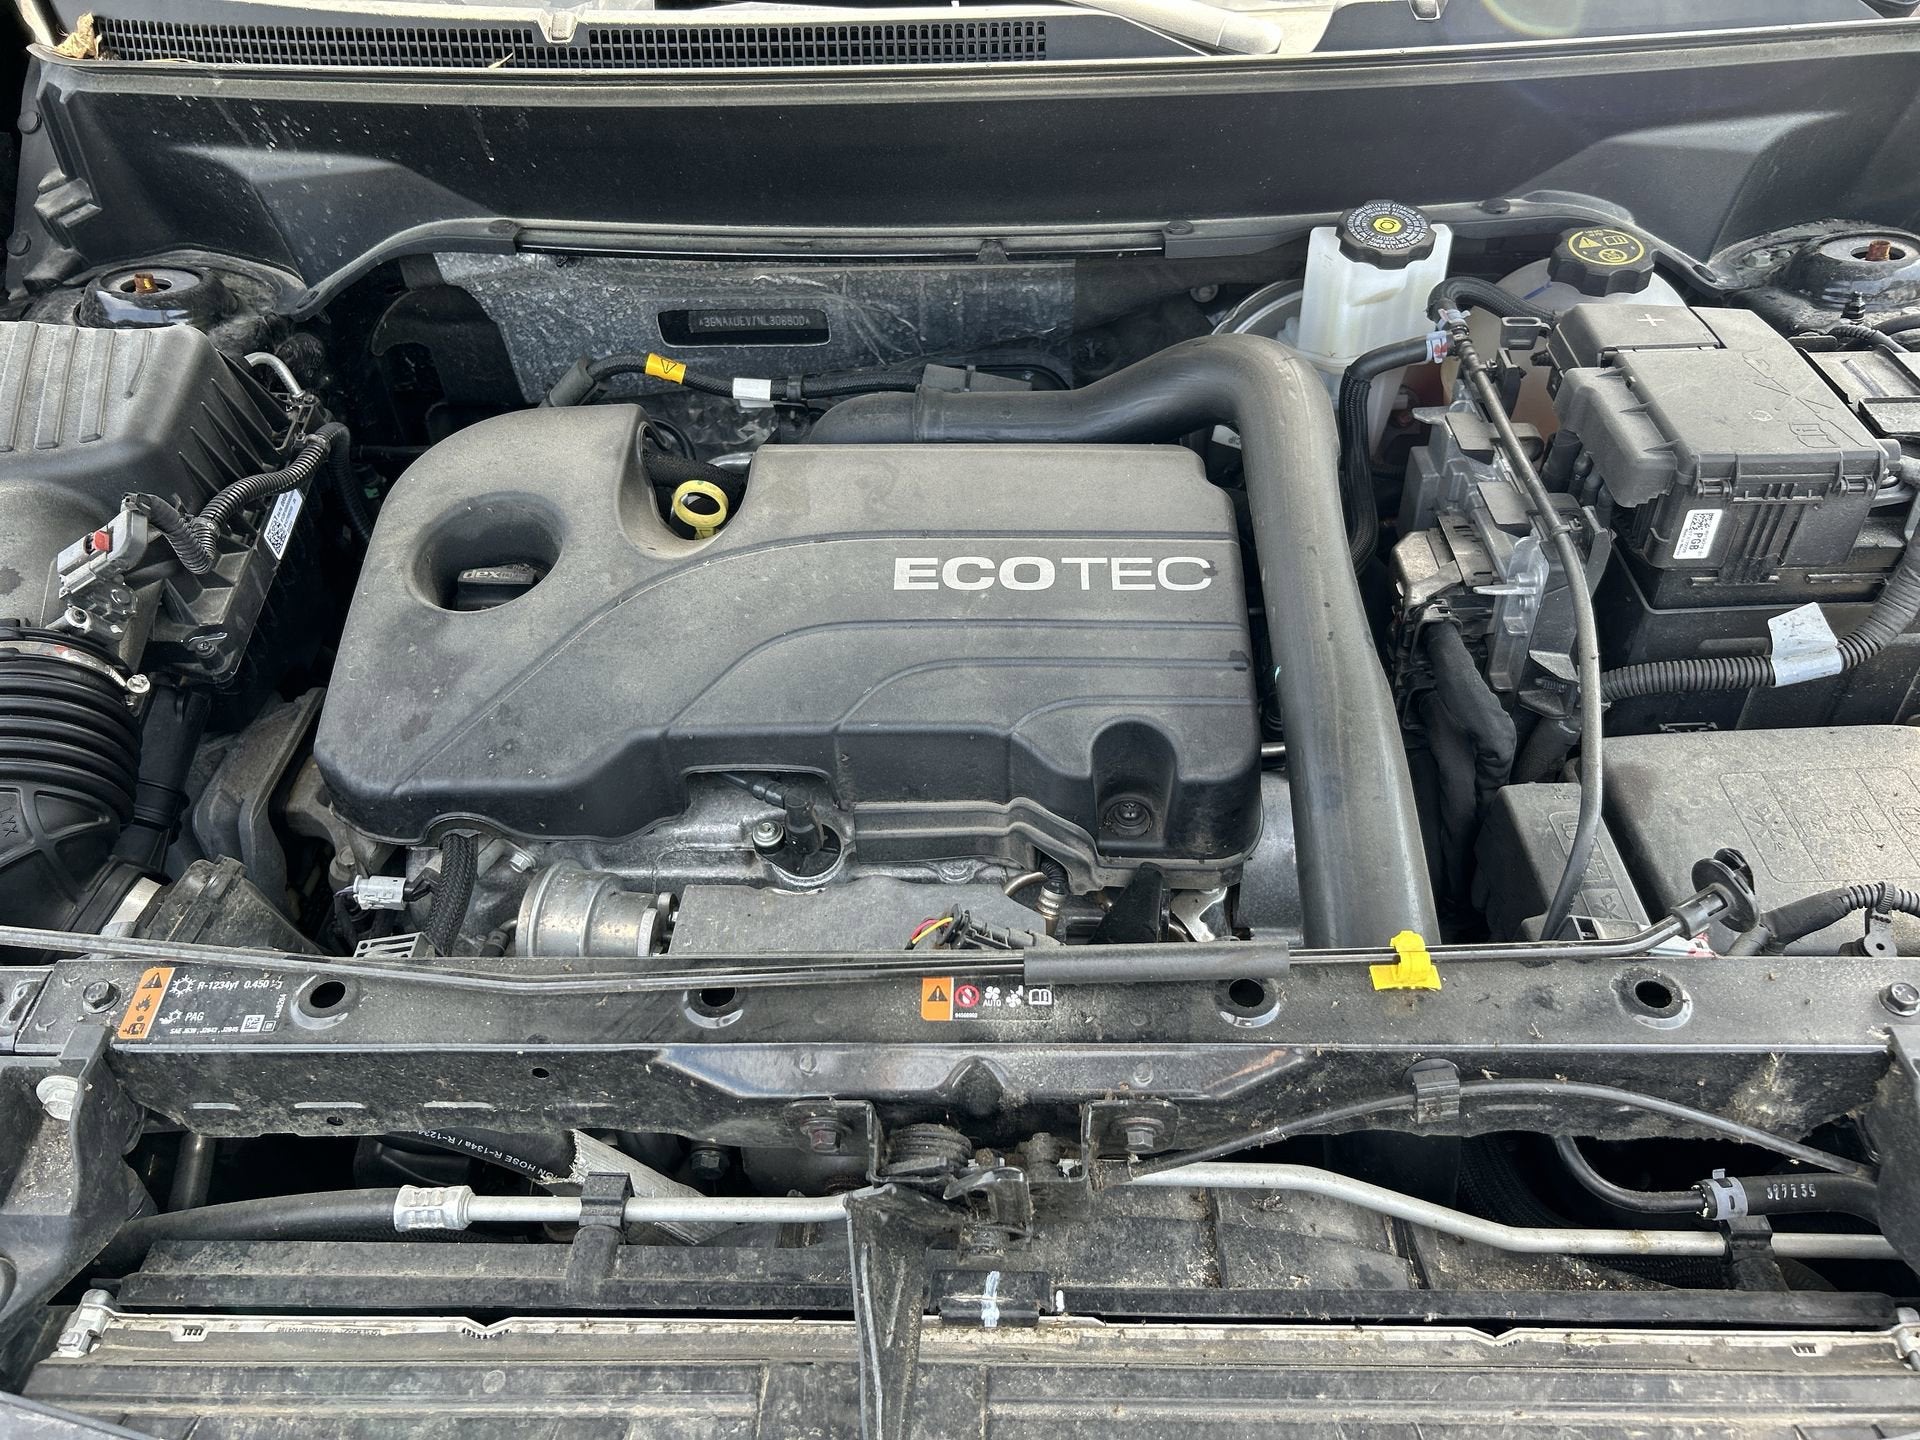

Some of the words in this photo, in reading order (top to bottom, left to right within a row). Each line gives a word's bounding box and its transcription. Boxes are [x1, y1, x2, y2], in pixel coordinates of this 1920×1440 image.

[1689, 532, 1703, 550] PGB
[893, 556, 1213, 591] ECOTEC
[197, 980, 240, 991] R-1234yf
[244, 980, 269, 989] 0.450
[983, 999, 1002, 1007] AUTO
[185, 1011, 205, 1022] PAG
[465, 1140, 503, 1159] R-134a
[504, 1154, 537, 1172] HOSE
